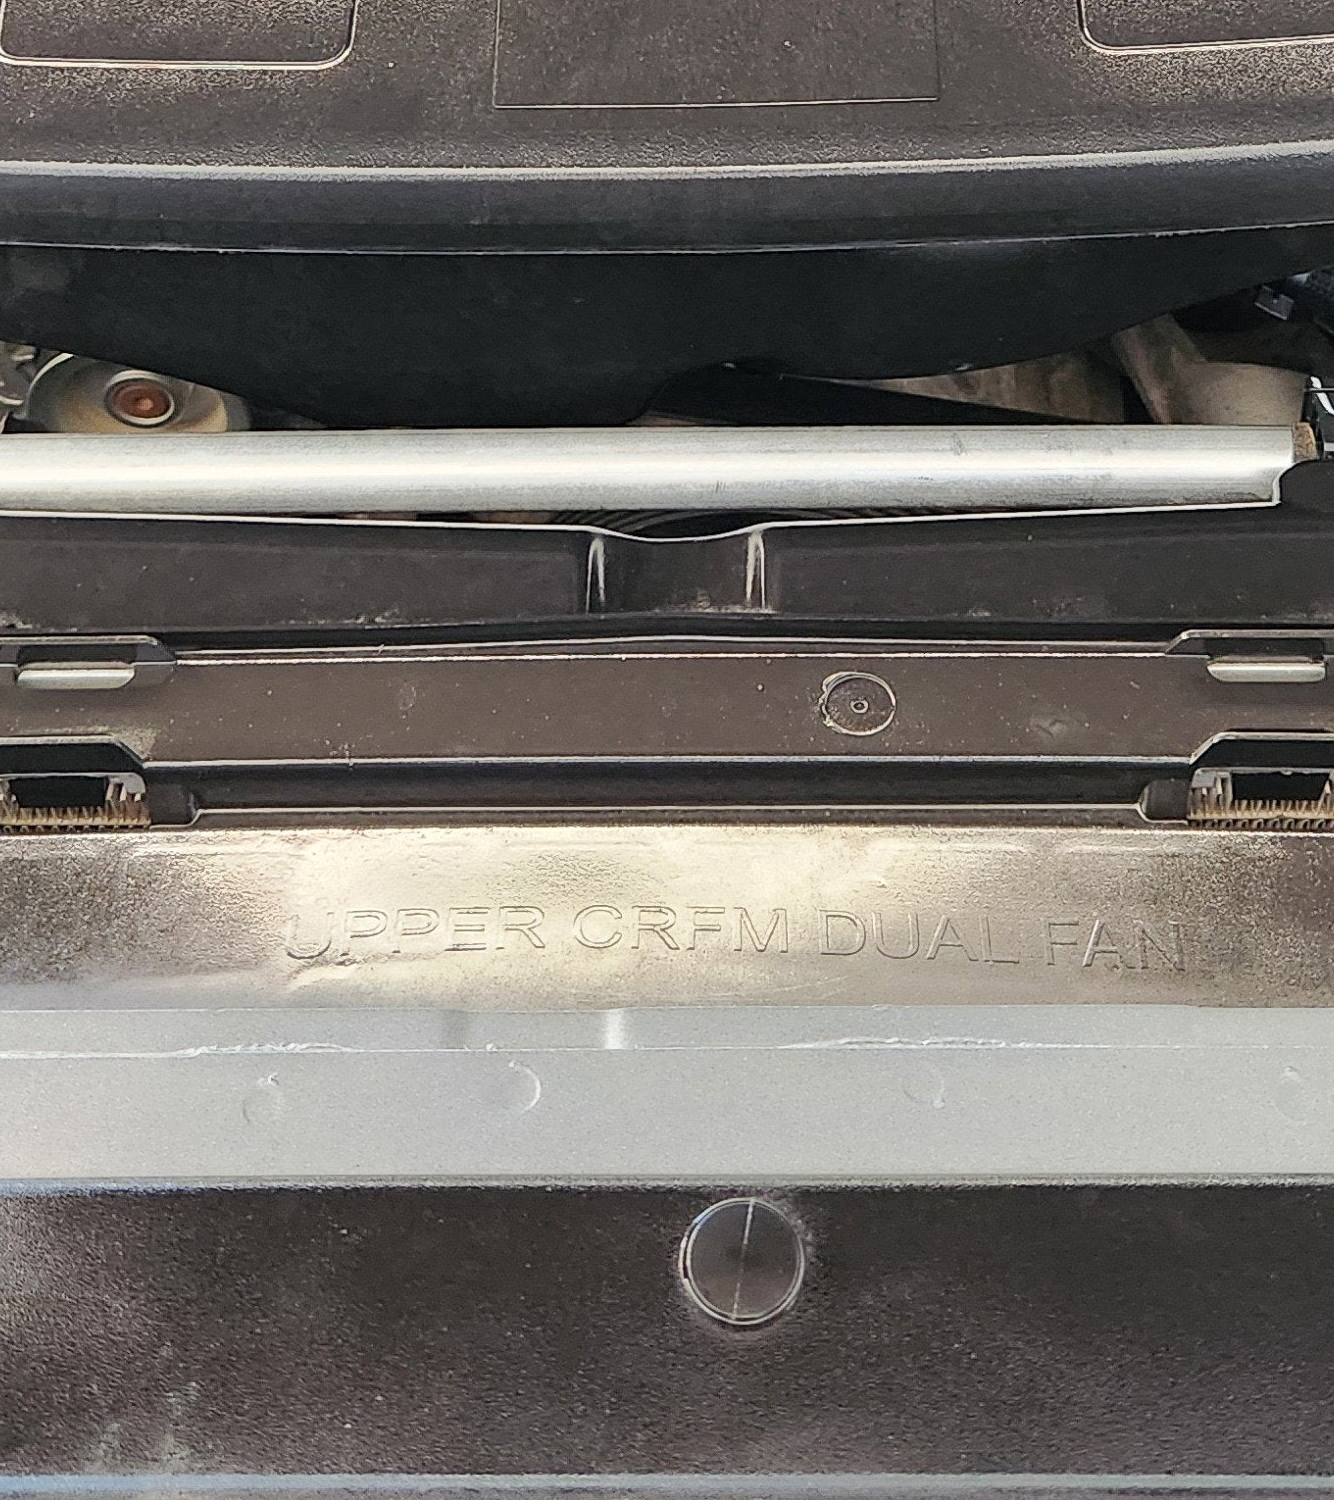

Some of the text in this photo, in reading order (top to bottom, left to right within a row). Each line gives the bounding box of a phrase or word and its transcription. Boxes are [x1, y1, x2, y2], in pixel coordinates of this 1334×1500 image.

[284, 904, 1186, 972] UPPER CRFM DUAL FAN
